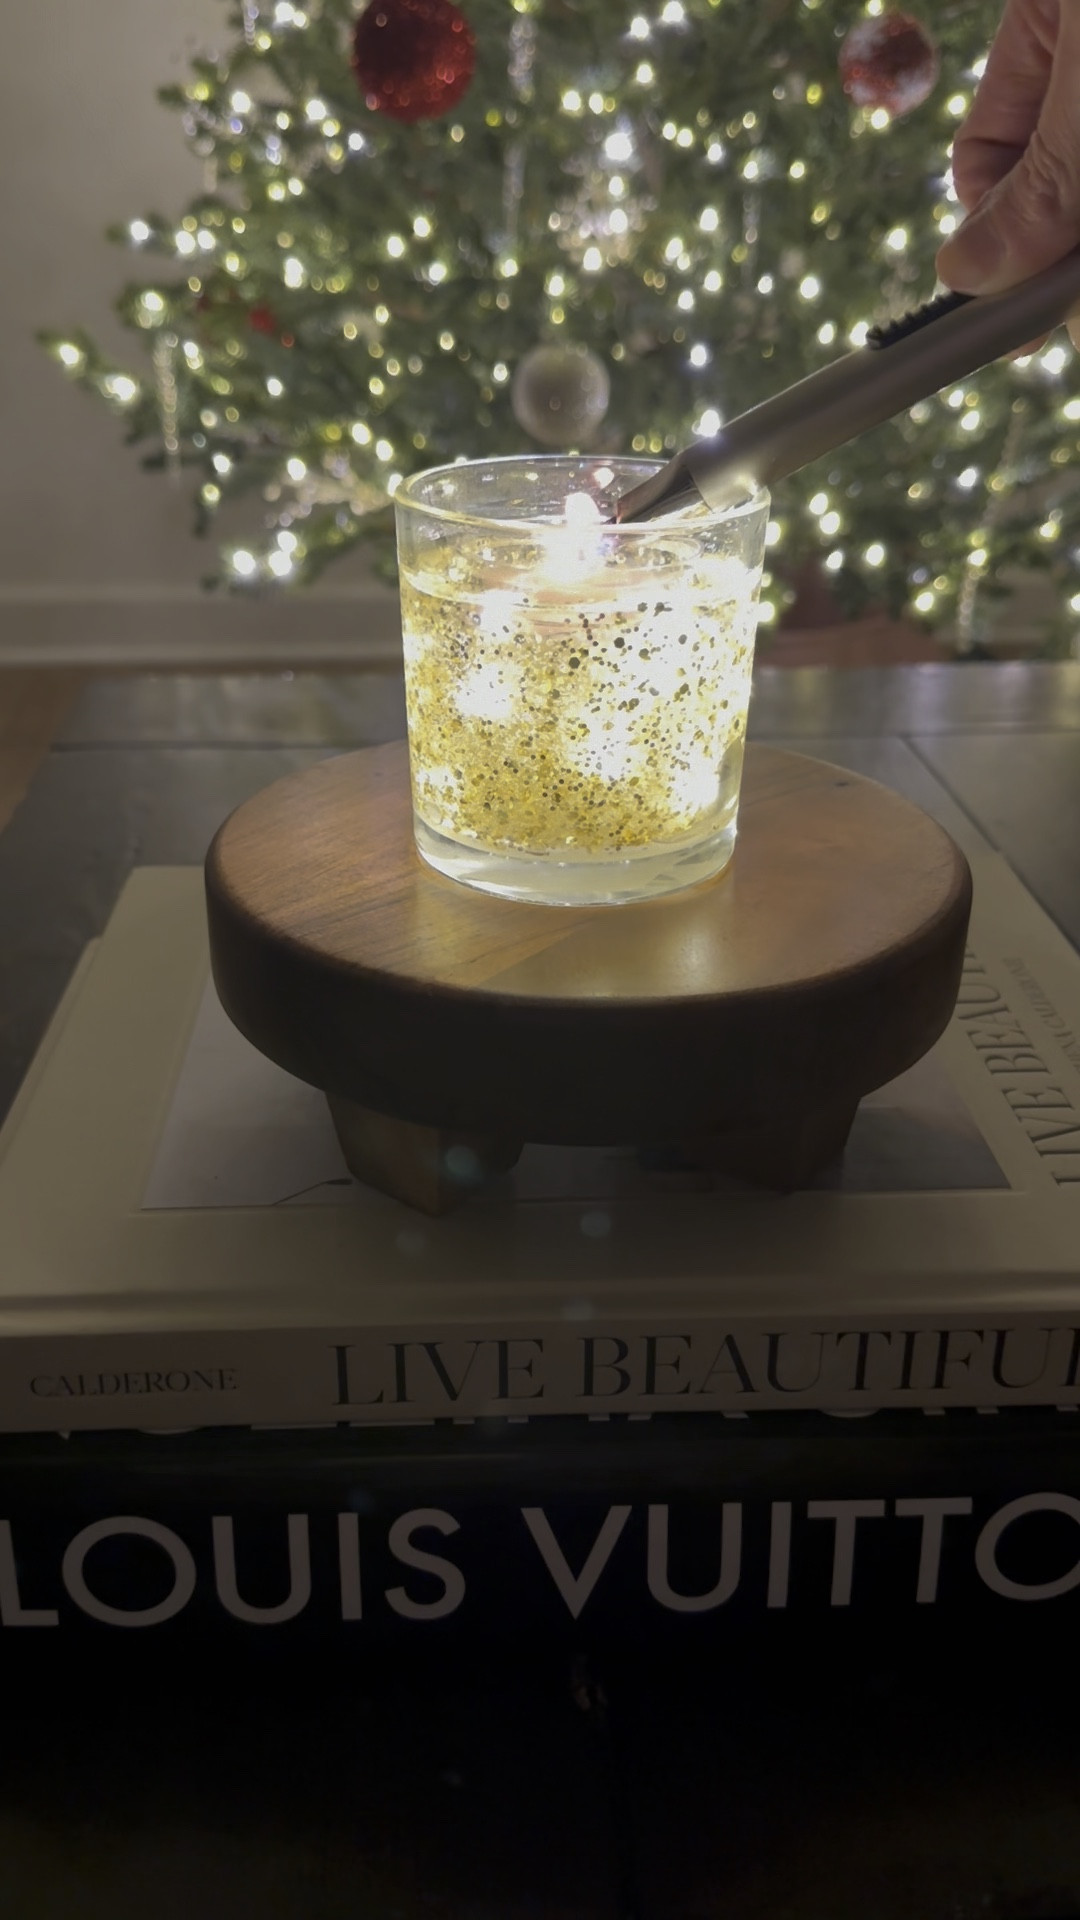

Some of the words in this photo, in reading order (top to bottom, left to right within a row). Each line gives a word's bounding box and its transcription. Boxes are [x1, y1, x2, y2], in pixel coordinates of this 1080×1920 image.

[29, 1368, 239, 1398] CALDERONE
[328, 1339, 546, 1406] LIVE
[0, 1507, 467, 1629] LOUIS
[520, 1491, 1080, 1622] VUITTO
